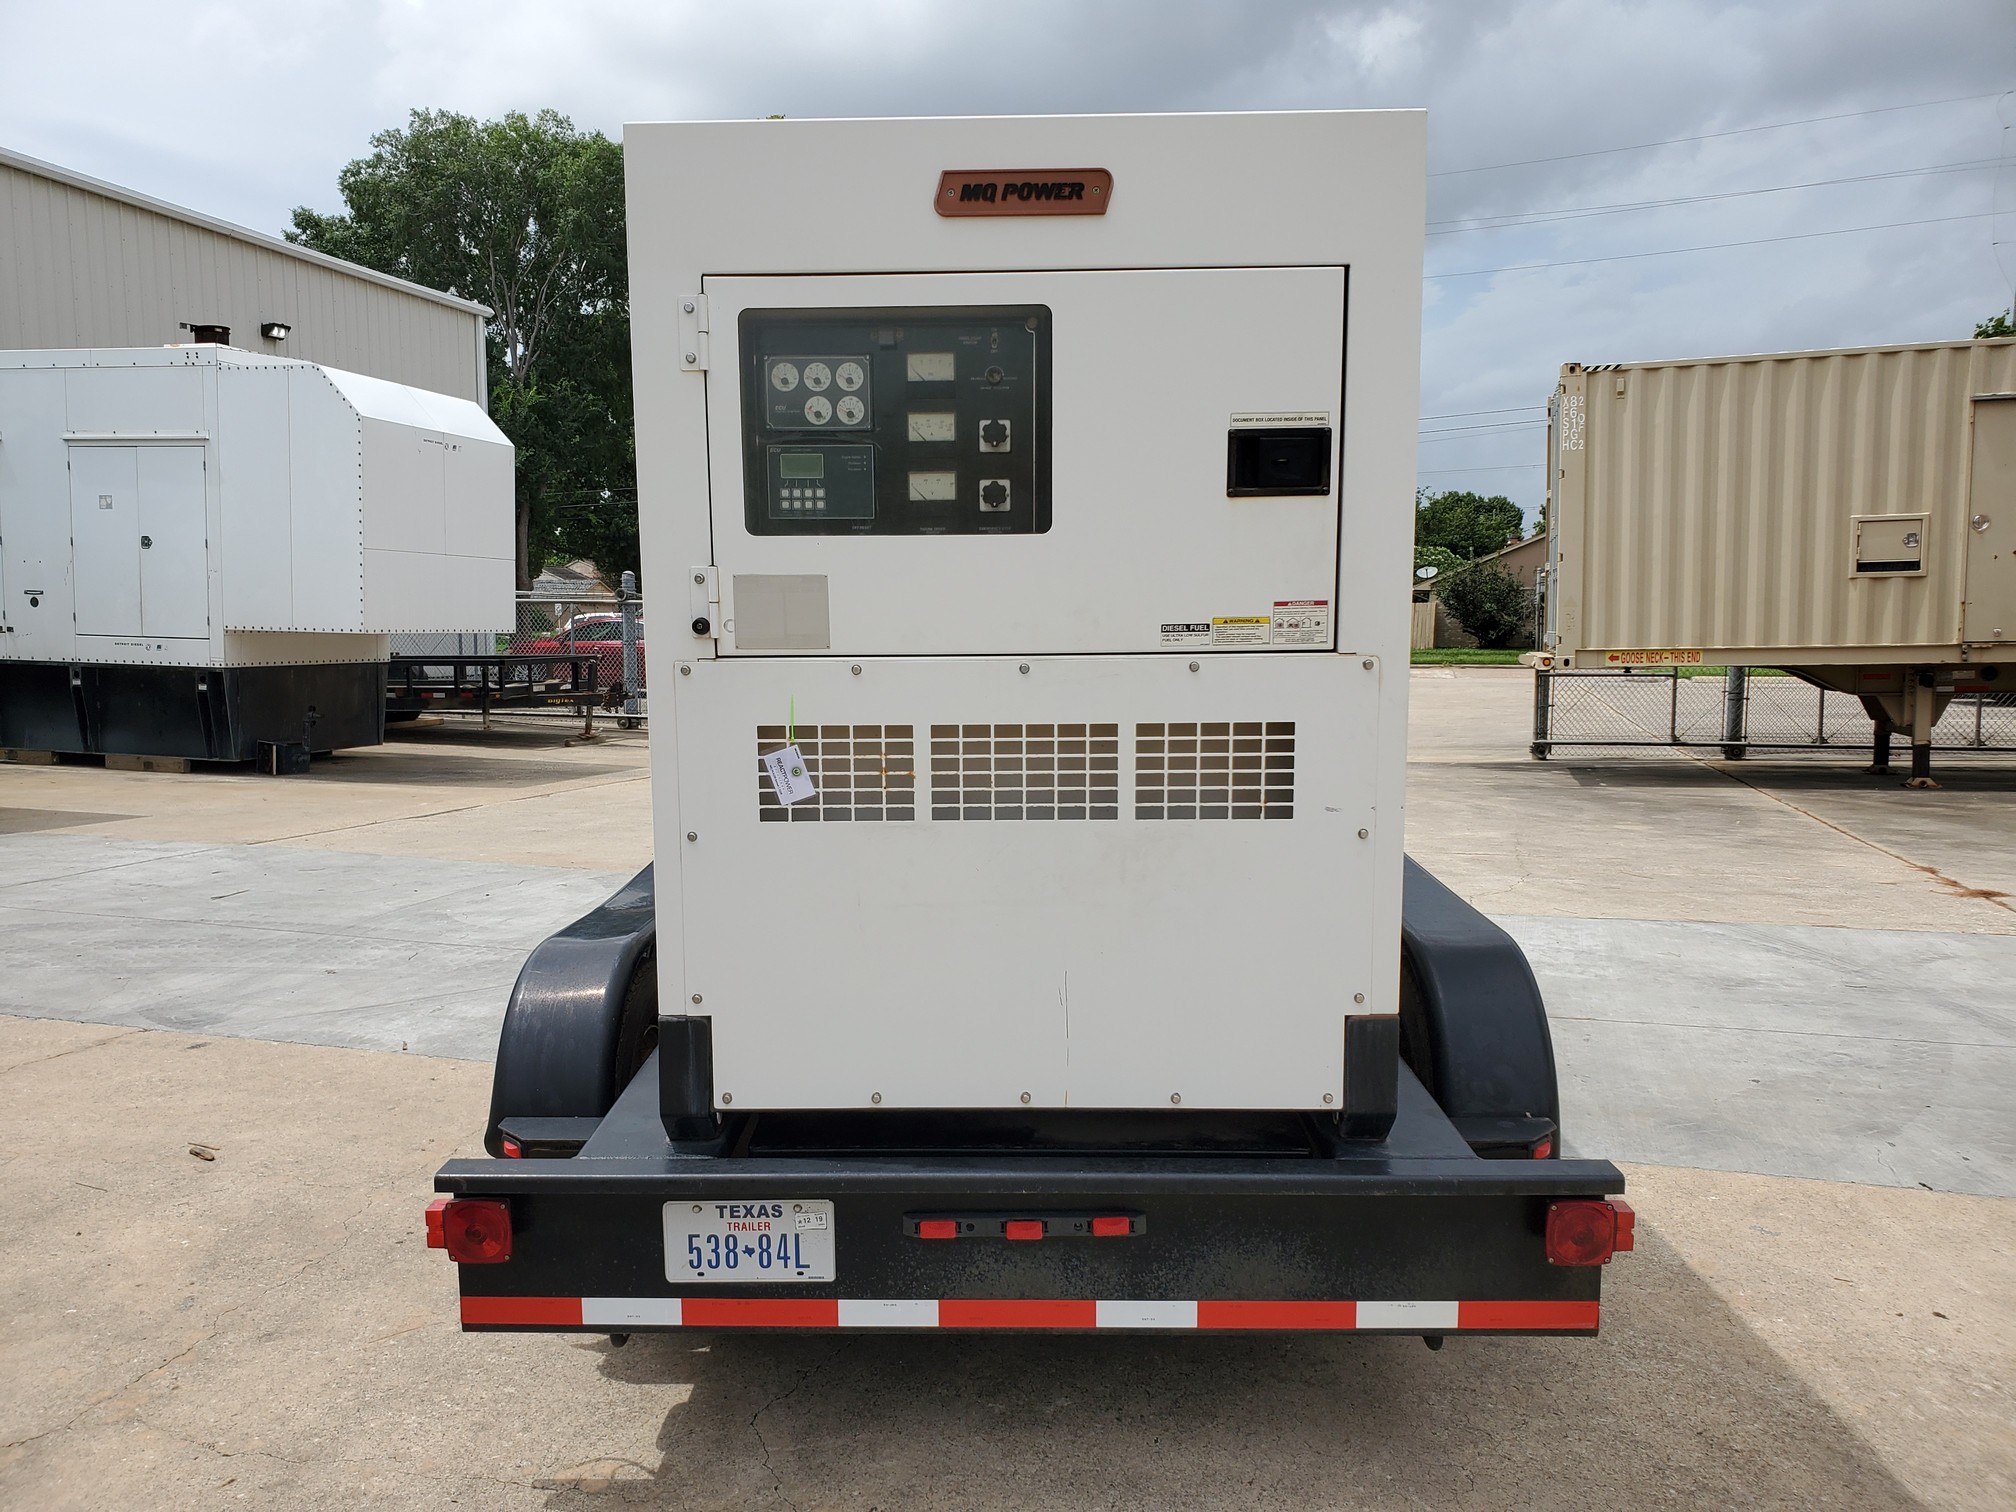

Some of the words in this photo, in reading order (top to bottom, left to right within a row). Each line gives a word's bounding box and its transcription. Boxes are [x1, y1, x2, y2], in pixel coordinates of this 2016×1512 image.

[959, 183, 998, 203] MQ
[1001, 182, 1085, 201] POWER
[1162, 624, 1188, 632] DIESEL
[1189, 623, 1209, 631] FUEL
[1620, 652, 1644, 664] GOOSE
[1687, 651, 1701, 663] END
[715, 1204, 783, 1219] TEXAS
[727, 1221, 771, 1231] TRAILER
